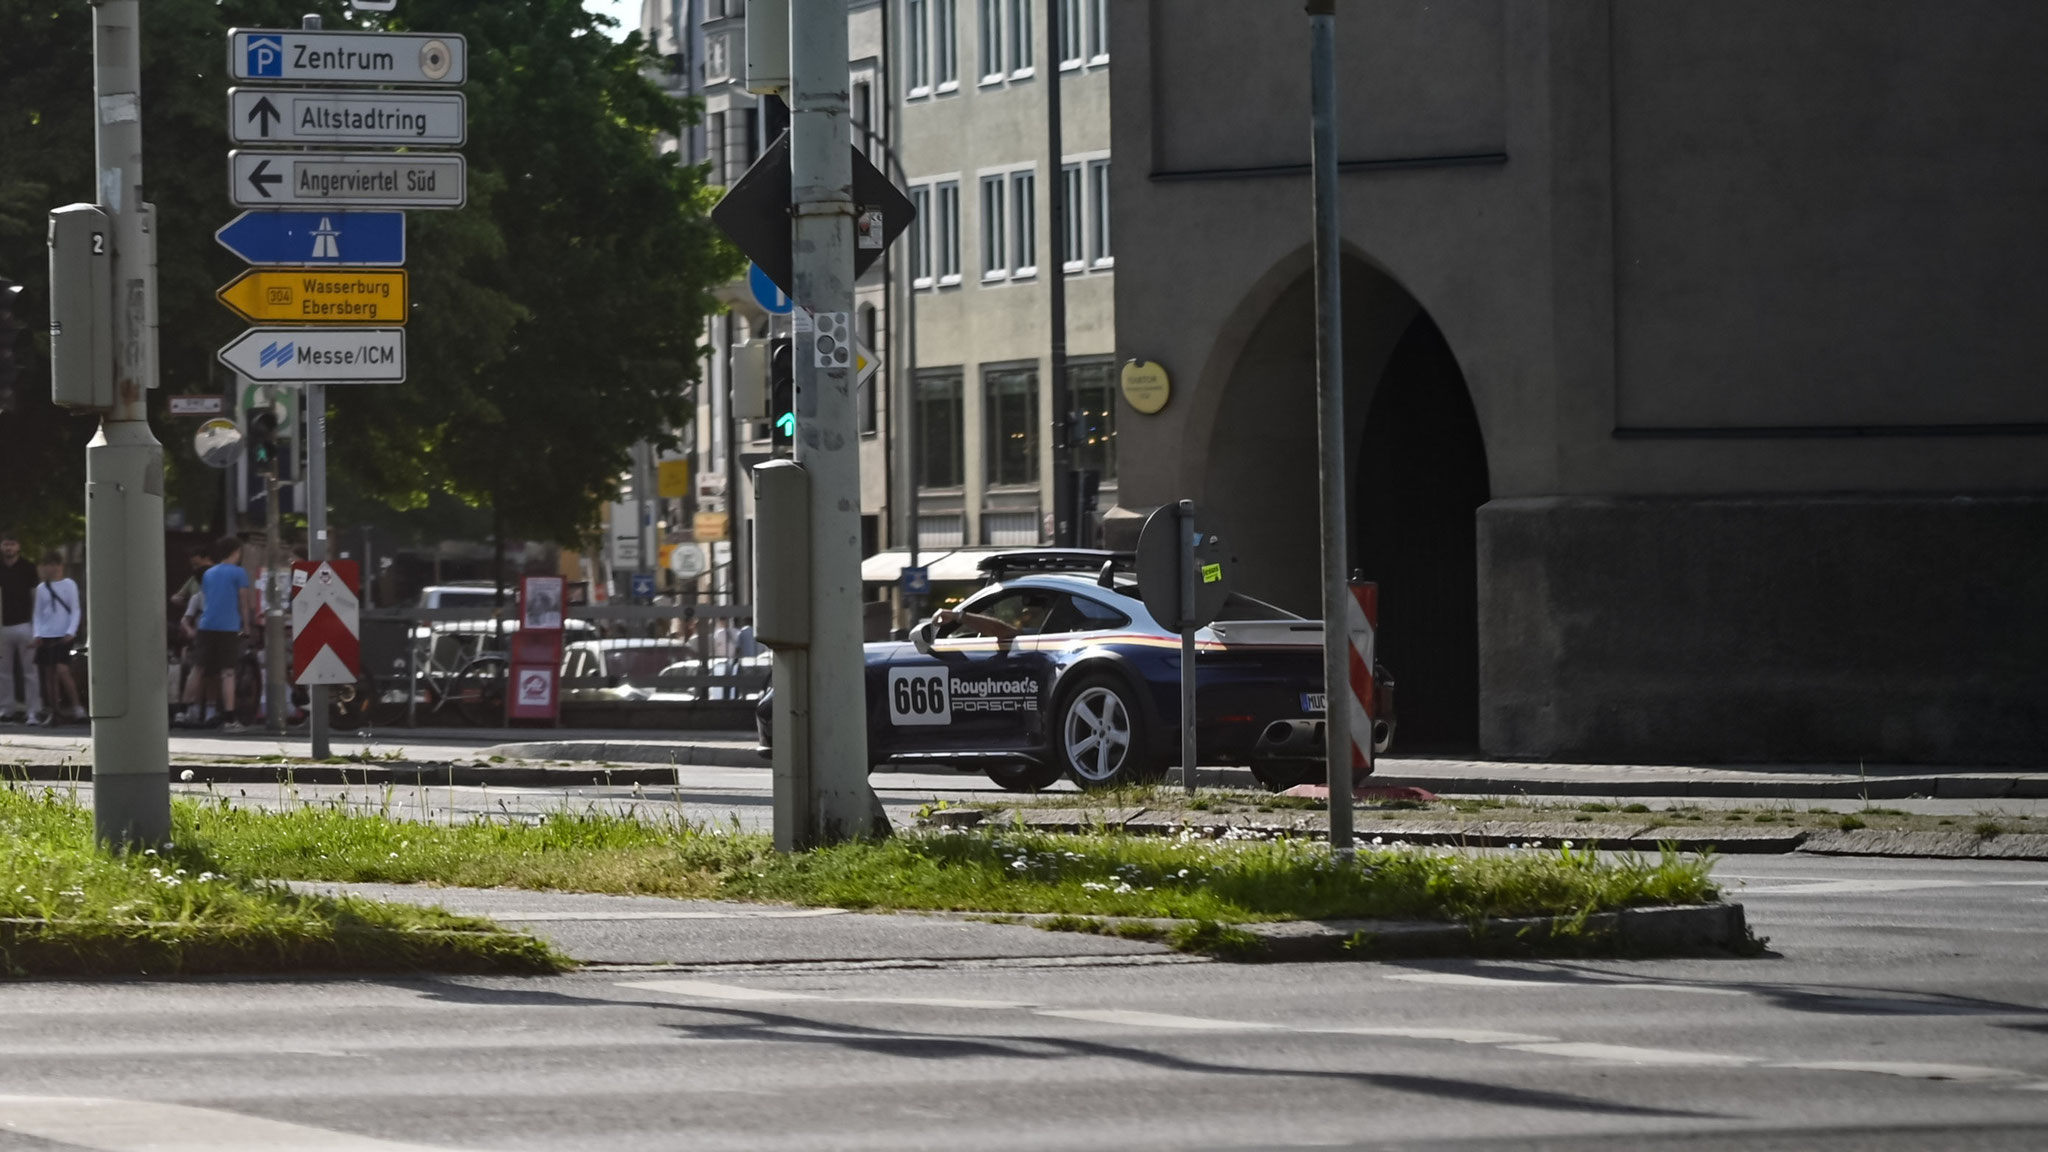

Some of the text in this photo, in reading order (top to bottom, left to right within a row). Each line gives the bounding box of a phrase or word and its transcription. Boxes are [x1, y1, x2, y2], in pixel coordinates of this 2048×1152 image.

[257, 44, 394, 75] P Zentrum
[301, 106, 427, 136] Altstadtring
[300, 168, 436, 196] Angerviertel Süd
[93, 234, 103, 253] 2
[269, 290, 290, 302] 304
[303, 279, 390, 298] Wasserburg
[302, 300, 377, 318] Ebersberg
[297, 346, 395, 365] Messe/ICM
[894, 676, 945, 715] 666
[950, 676, 1038, 697] Roughroads
[951, 700, 1038, 711] PORSCHE
[1307, 695, 1326, 709] MUC
